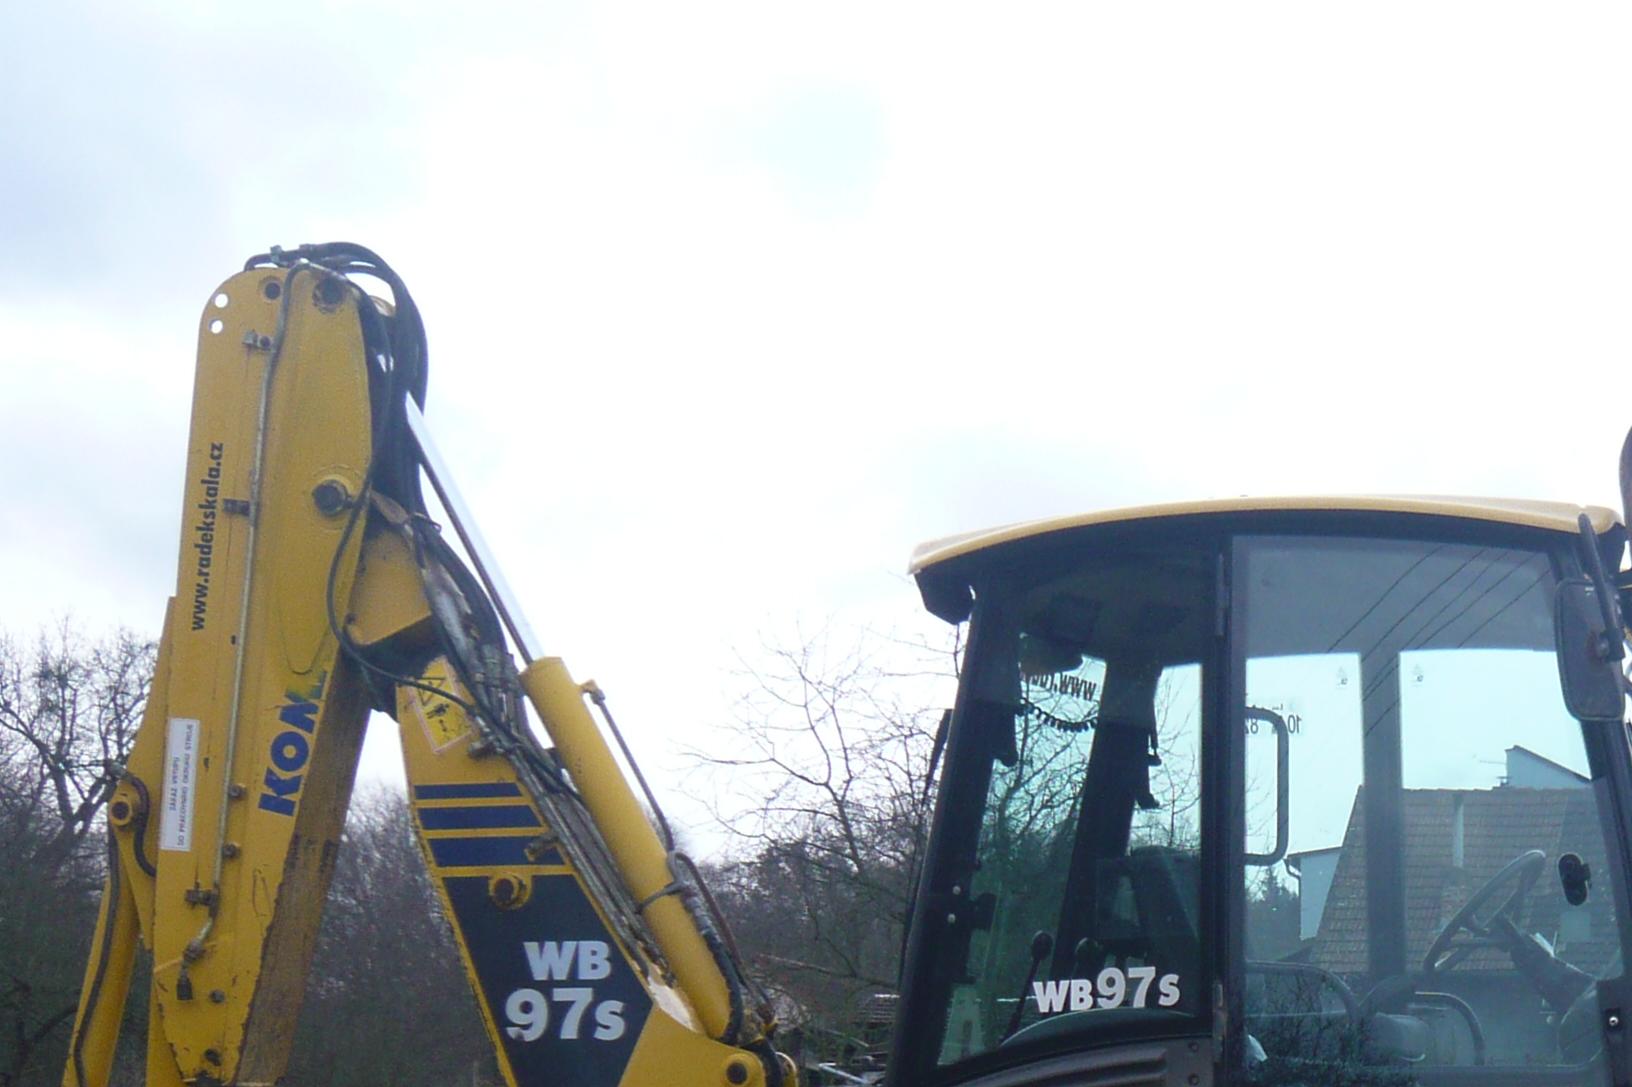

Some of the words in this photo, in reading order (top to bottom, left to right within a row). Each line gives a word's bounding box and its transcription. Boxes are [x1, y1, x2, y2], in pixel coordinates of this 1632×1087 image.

[192, 442, 224, 632] www.radekskala.cz
[258, 670, 328, 817] KOM
[523, 940, 612, 981] WB
